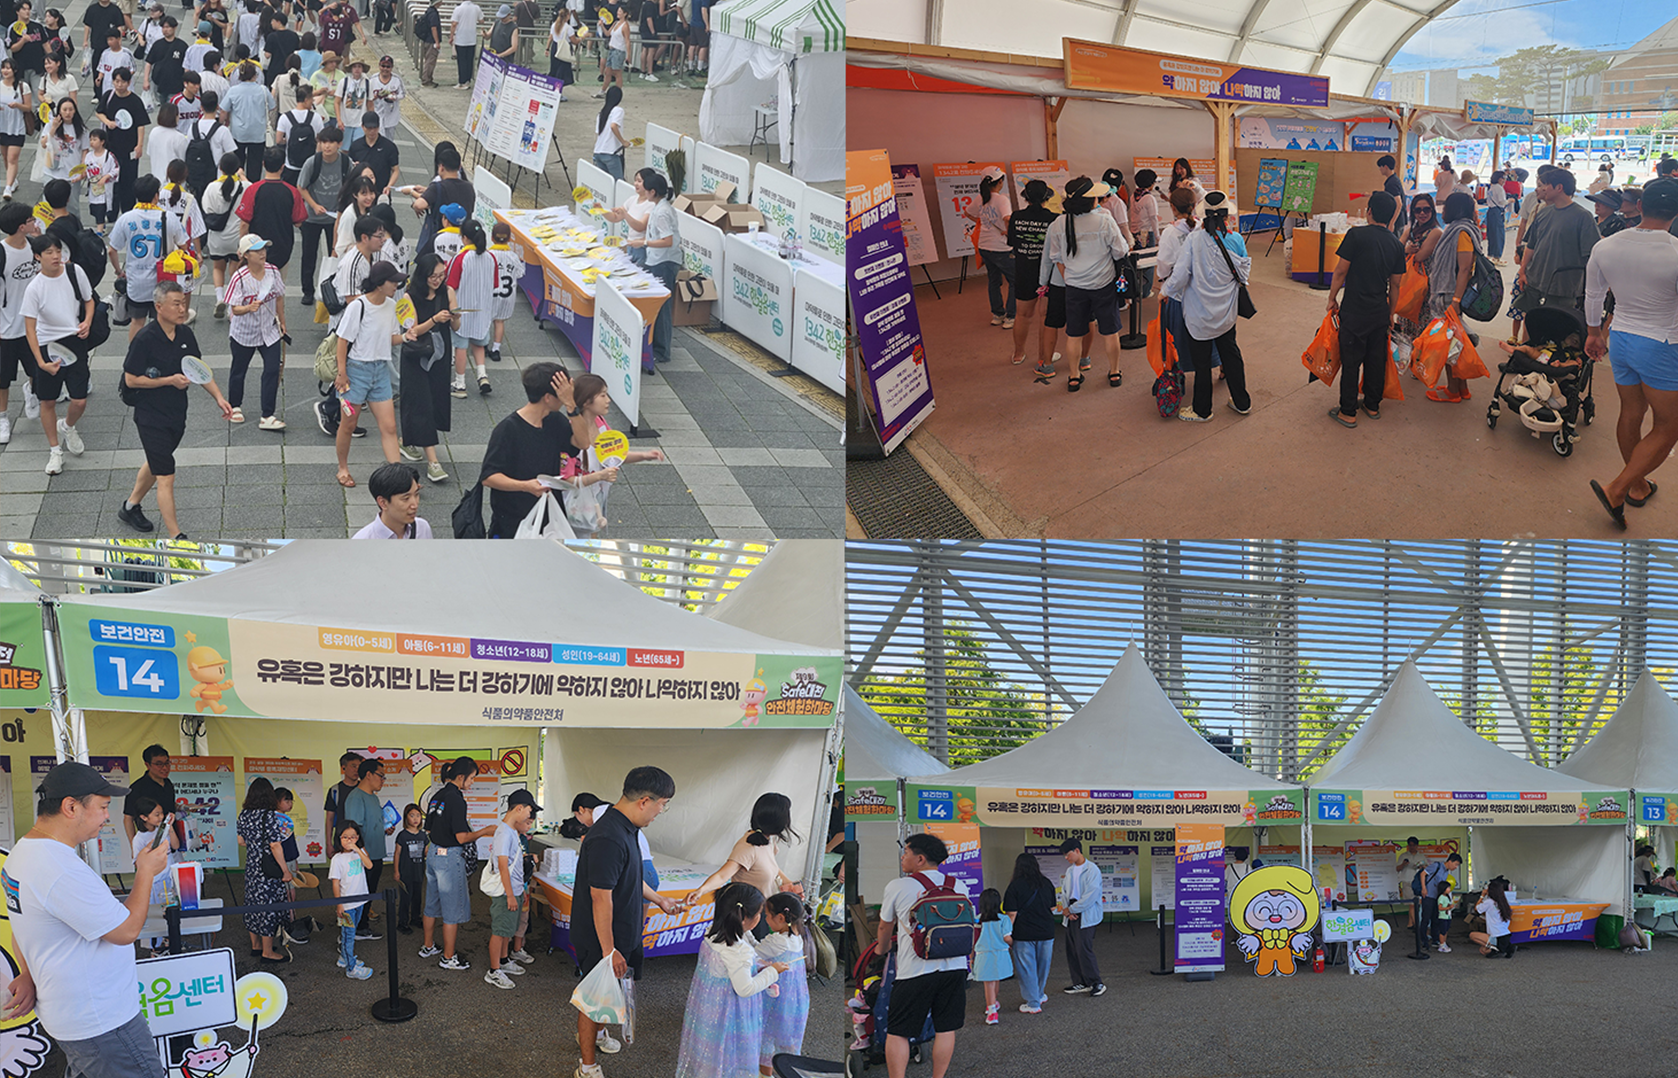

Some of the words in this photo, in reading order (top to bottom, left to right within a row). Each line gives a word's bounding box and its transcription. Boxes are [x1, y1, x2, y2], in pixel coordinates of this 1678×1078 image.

[1162, 74, 1197, 93] 약하지
[1199, 79, 1221, 96] 않아
[1224, 81, 1262, 99] 나약하지
[1264, 85, 1282, 101] 않아
[872, 180, 893, 205] 않아
[879, 194, 897, 221] 않아
[130, 233, 162, 259] 67
[732, 276, 750, 299] 1342
[804, 316, 826, 342] 1342
[99, 623, 166, 644] 보건안전
[321, 632, 393, 650] 영유아(0~5세)
[403, 639, 466, 655] 아동(6~11세)
[476, 642, 549, 660] 청소년(12~18세)
[561, 649, 621, 664] 성인(19~64세)
[109, 656, 165, 693] 14
[256, 658, 326, 686] 유혹은
[328, 662, 413, 691] 강하지만
[415, 667, 456, 693] 나는
[458, 670, 478, 694] 더
[481, 671, 554, 697] 강하기에
[556, 674, 608, 698] 약하지
[609, 677, 644, 700] 않아
[645, 678, 708, 700] 나약하지
[710, 681, 742, 702] 않아
[781, 682, 825, 699] Safe대전
[481, 706, 564, 722] 식품의약품안전처
[766, 698, 834, 717] 안전체험한마당
[923, 802, 948, 818] 14
[987, 802, 1019, 814] 유혹은
[1020, 802, 1062, 814] 강하지만
[1062, 803, 1083, 814] 나는
[1083, 803, 1095, 814] 더
[1095, 803, 1135, 815] 강하기에
[1135, 803, 1165, 815] 약하지
[1165, 803, 1185, 815] 않아
[1185, 803, 1222, 815] 나약하지
[1222, 803, 1242, 814] 않아
[1322, 805, 1341, 818] 14
[1647, 807, 1661, 819] 13
[1071, 829, 1098, 842] 않아
[1102, 829, 1151, 842] 나약하지
[1325, 917, 1371, 936] 한걸음센터
